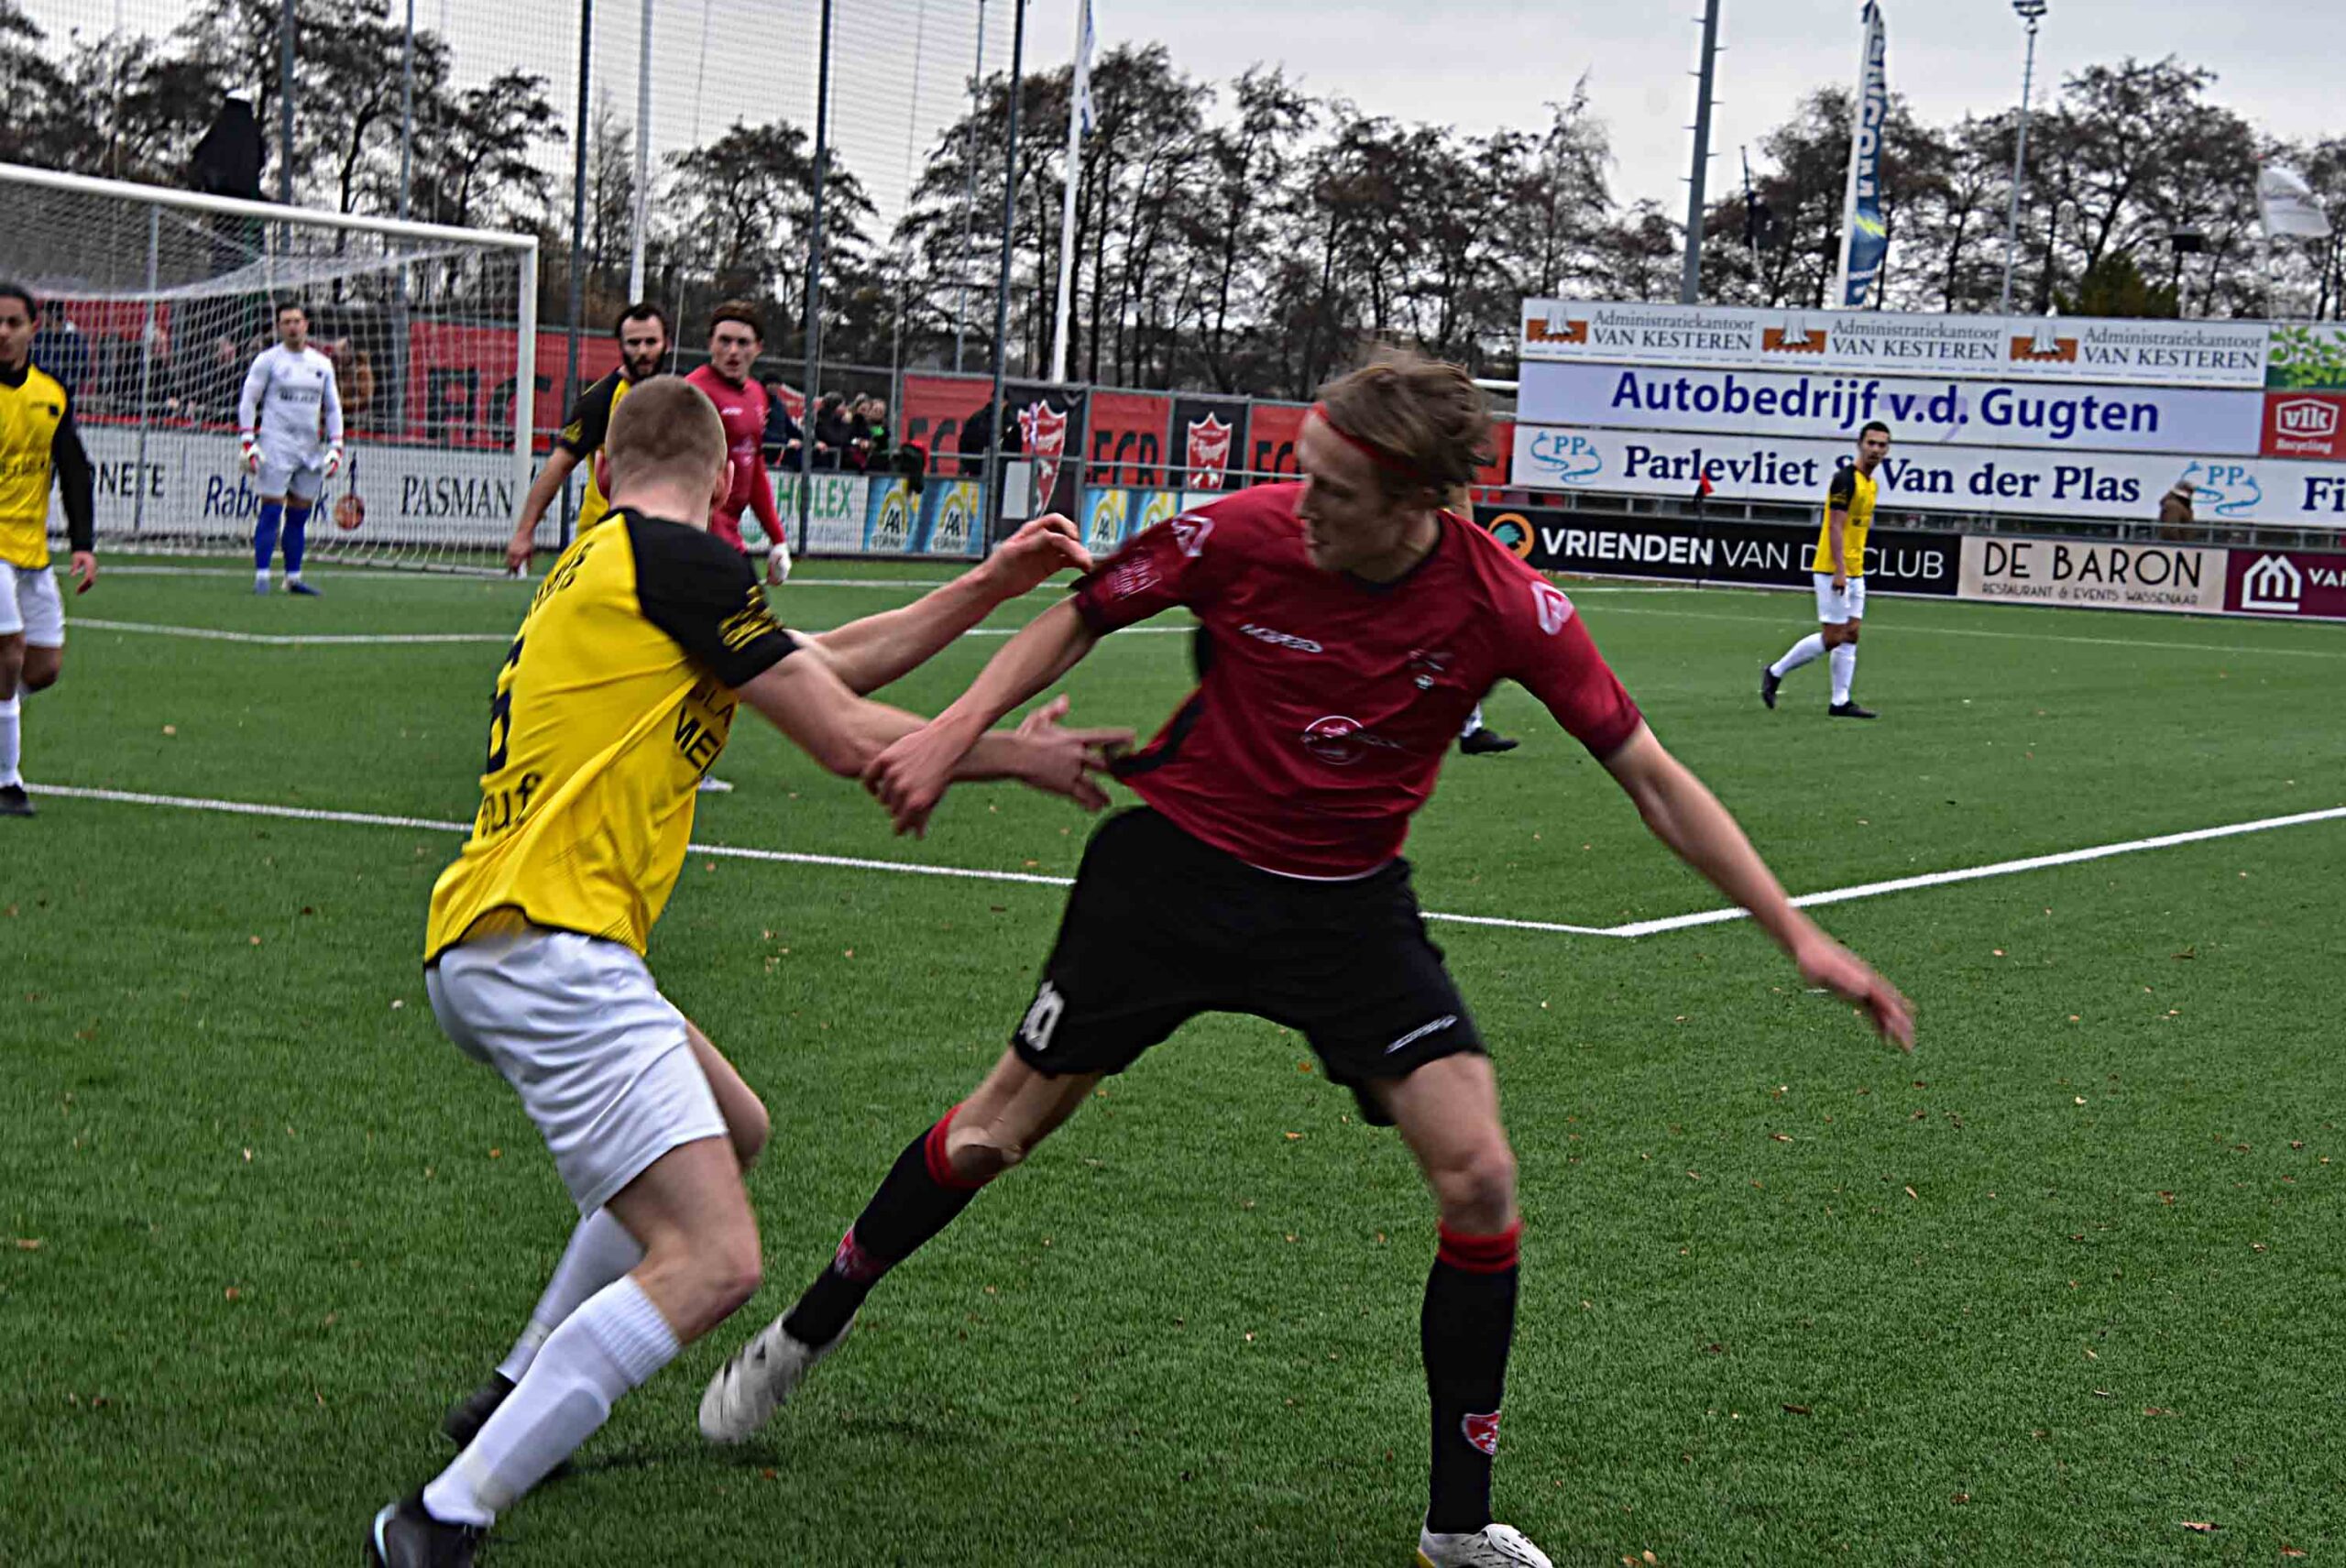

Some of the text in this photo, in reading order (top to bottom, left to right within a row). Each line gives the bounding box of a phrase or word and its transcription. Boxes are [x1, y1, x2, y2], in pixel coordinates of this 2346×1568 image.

[1593, 310, 1755, 331] Administratiekantoor
[1833, 318, 2001, 340] Administratiekantoor
[1593, 327, 1752, 351] VAN KESTEREN
[1832, 336, 1999, 360] VAN KESTEREN
[2084, 325, 2262, 348] Administratiekantoor
[2084, 345, 2259, 368] VAN KESTEREN
[1611, 371, 2159, 440] Autobedrijf v.d. Gugten
[1553, 435, 1586, 455] PP
[1623, 445, 1818, 487] Parlevliet
[1880, 458, 1954, 493] Van
[1969, 463, 2040, 498] der
[2052, 466, 2140, 503] Plas
[2207, 466, 2244, 487] PP
[401, 474, 515, 518] PASMAN
[1540, 526, 1714, 566] VRIENDEN
[1720, 540, 1790, 571] VAN
[1863, 546, 1945, 580] CLUB
[1983, 541, 2202, 587] DE BARON
[1982, 583, 2053, 598] RESTAURANT
[2073, 588, 2120, 602] EVENTS
[2126, 591, 2198, 606] WASSENAAR
